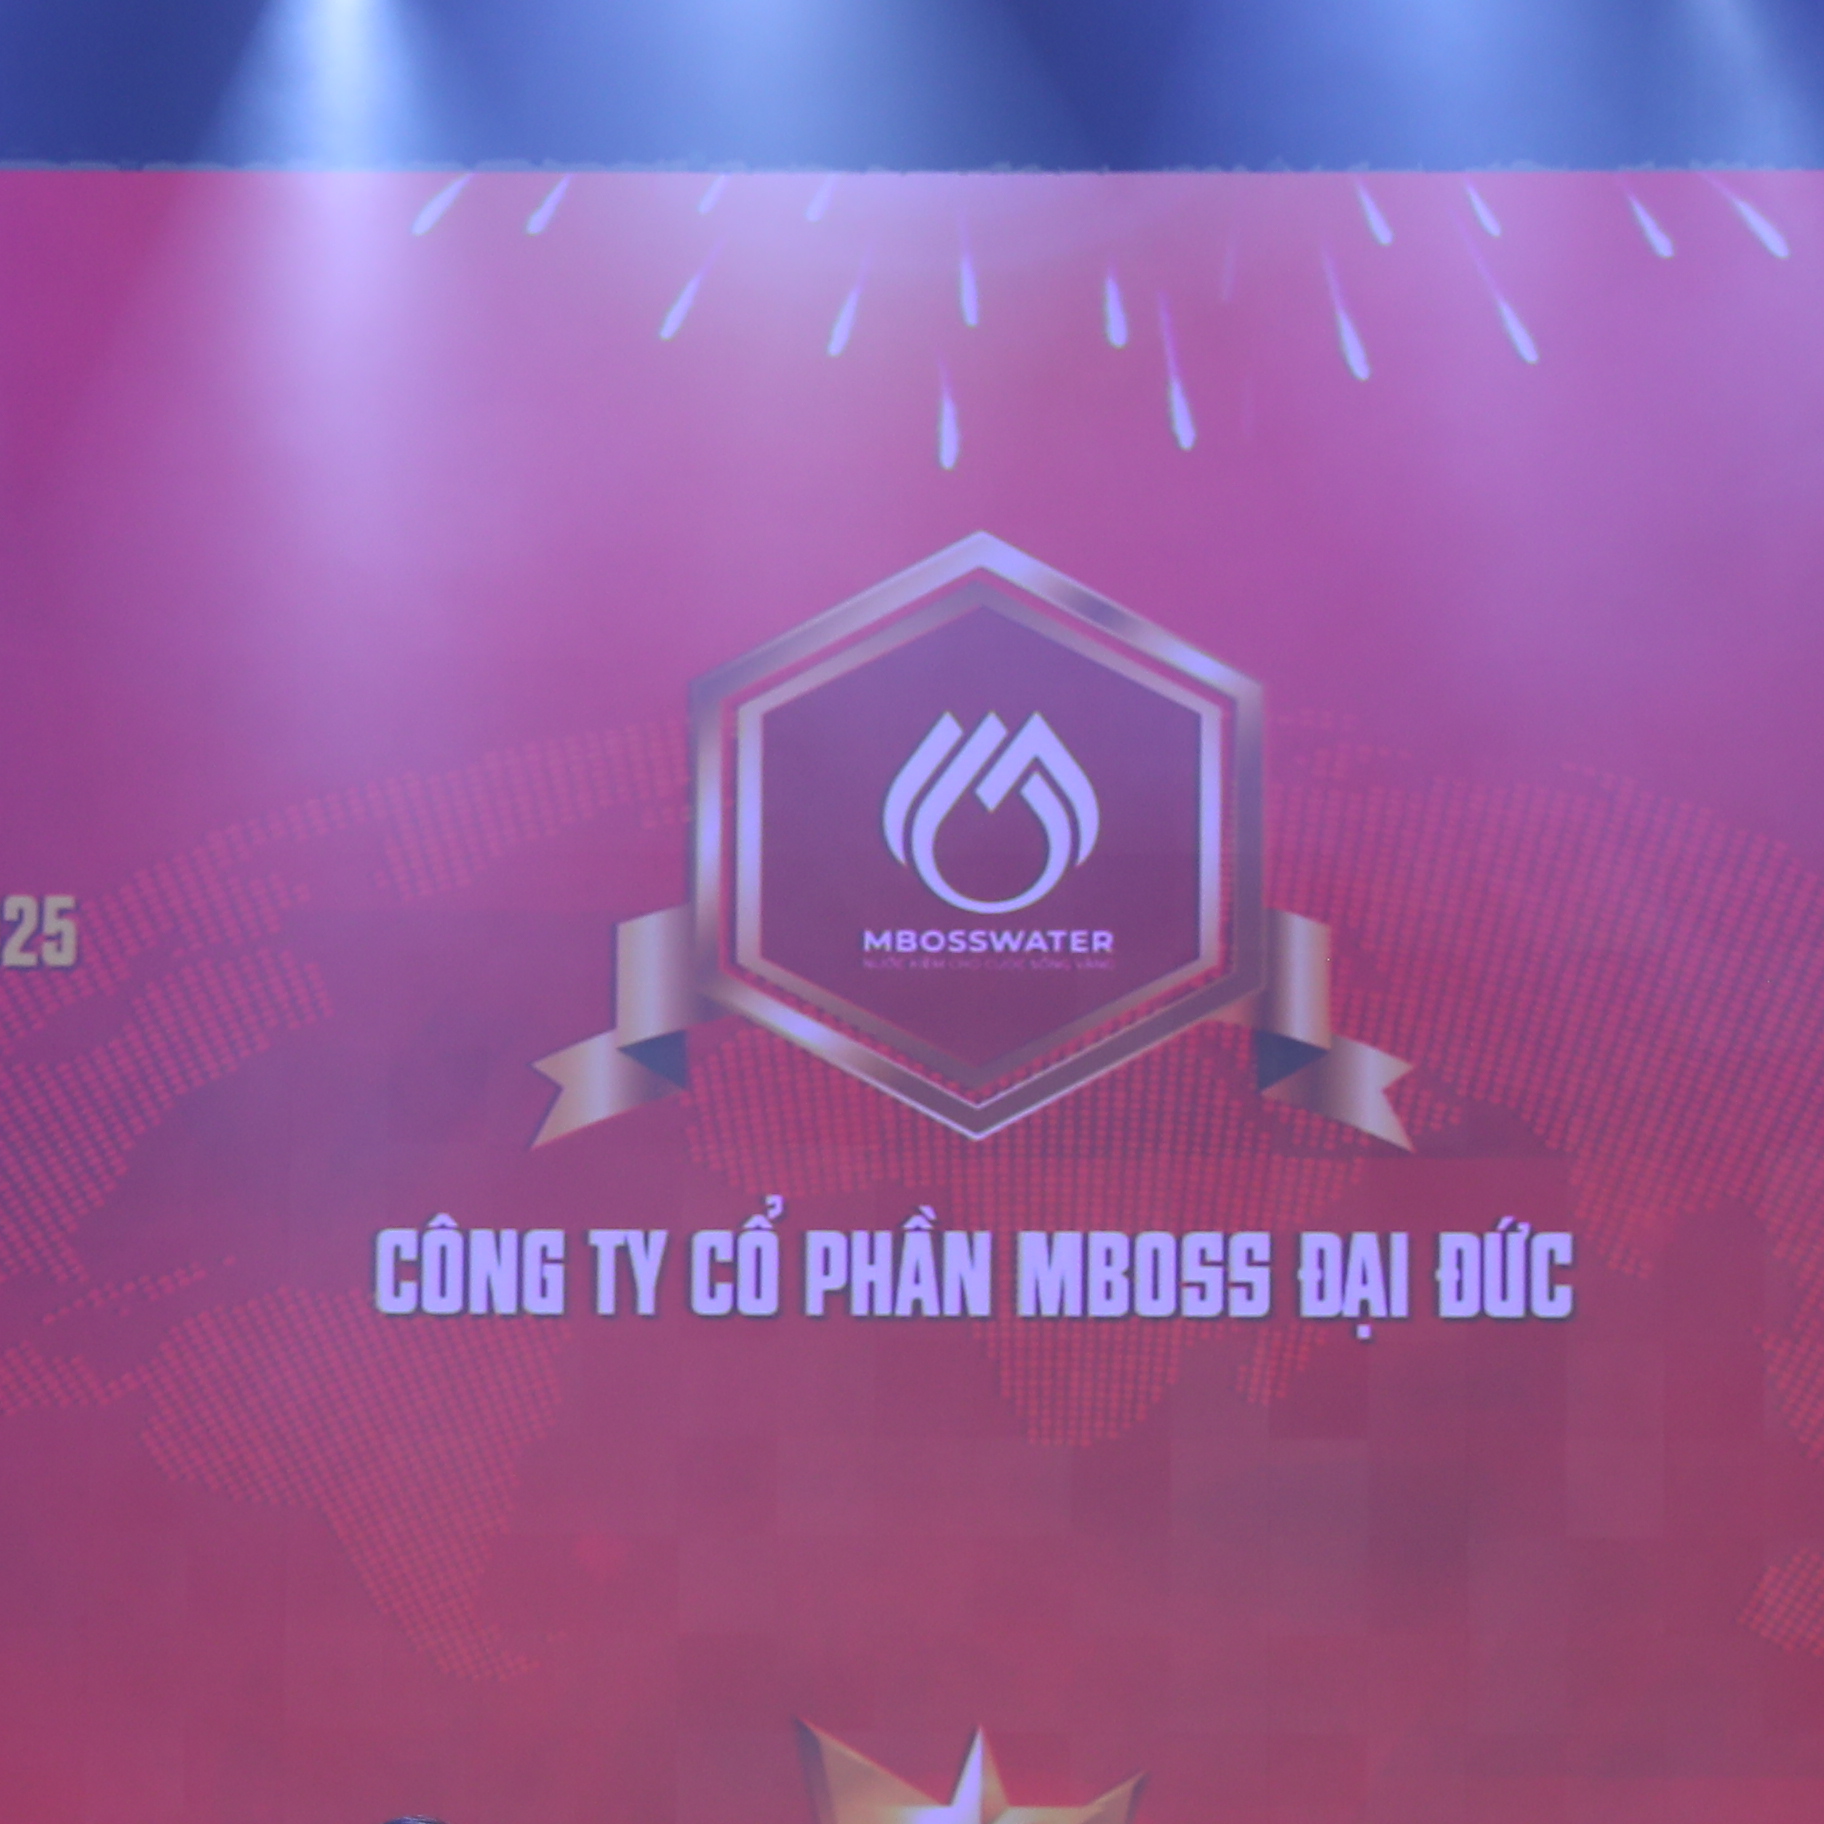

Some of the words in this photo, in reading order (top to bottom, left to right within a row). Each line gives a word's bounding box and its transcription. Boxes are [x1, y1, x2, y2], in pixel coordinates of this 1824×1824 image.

[862, 928, 1114, 954] MBOSSWATER
[375, 1211, 565, 1316] CÔNG
[588, 1228, 669, 1316] TY
[690, 1193, 784, 1316] CỔ
[804, 1204, 992, 1317] PHẦN
[1016, 1230, 1271, 1318] MBOSS
[1297, 1230, 1409, 1340] ĐẠI
[1435, 1215, 1574, 1318] ĐỨC
